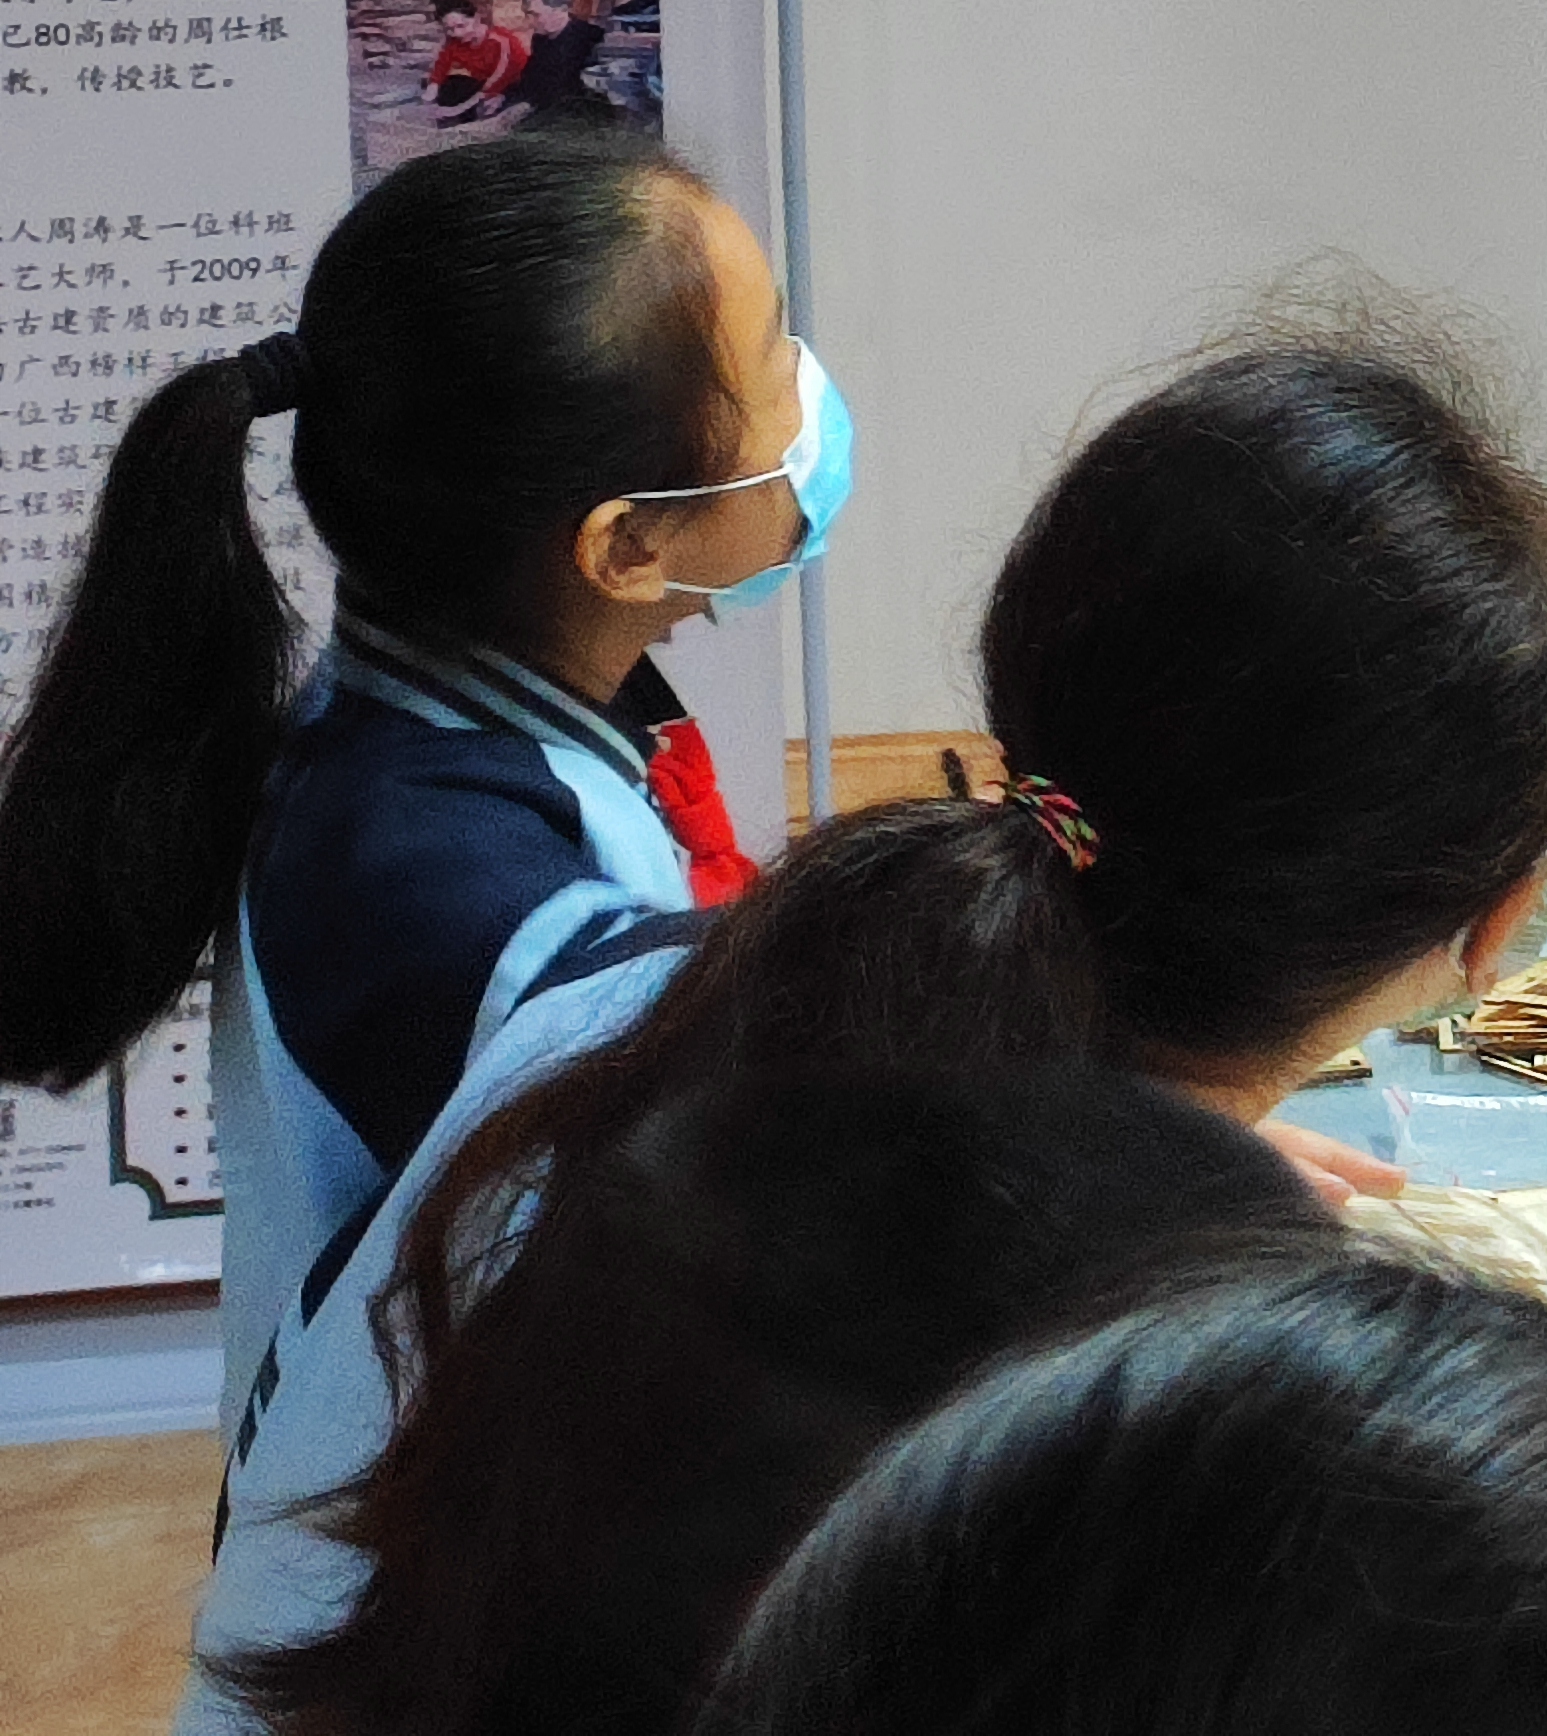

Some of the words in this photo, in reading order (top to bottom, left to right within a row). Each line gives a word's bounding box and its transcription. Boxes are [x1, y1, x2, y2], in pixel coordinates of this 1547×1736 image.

[0, 210, 297, 244] 人周涛是一位科班
[0, 254, 298, 291] 艺大师，于2009年
[0, 301, 297, 335] 古建资质的建筑公
